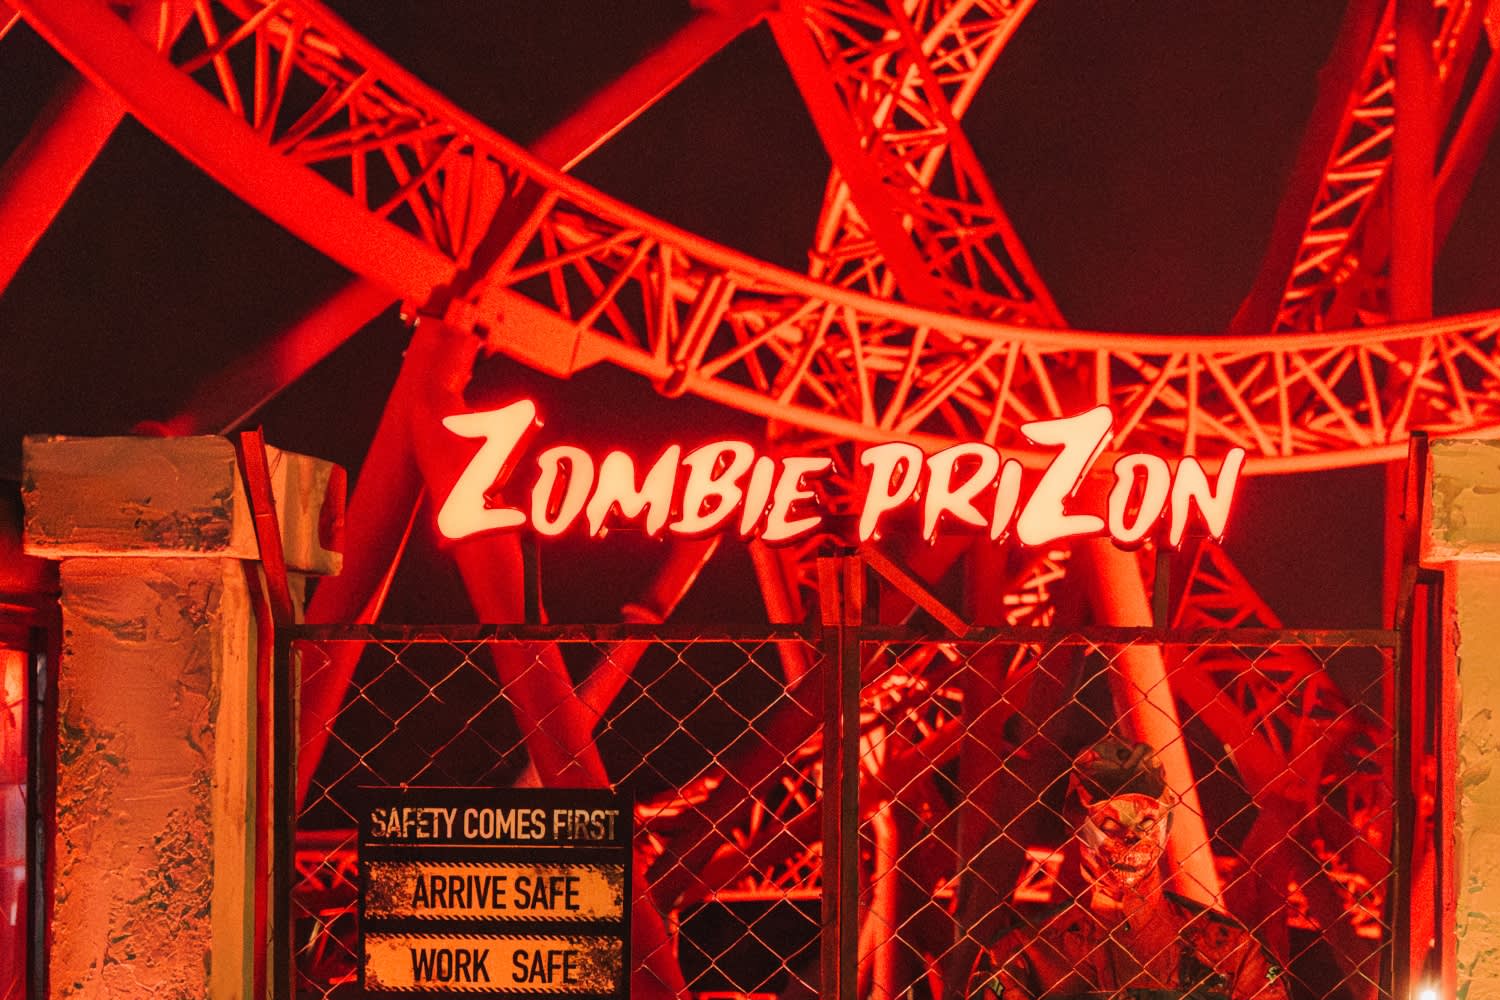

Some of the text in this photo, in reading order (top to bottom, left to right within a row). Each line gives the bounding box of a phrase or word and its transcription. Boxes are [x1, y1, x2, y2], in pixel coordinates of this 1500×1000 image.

[436, 399, 836, 541] ZOMBIE
[370, 807, 620, 840] SAFETY COMES FIRST
[412, 875, 581, 911] ARRIVE SAFE
[411, 948, 579, 984] WORK SAFE
